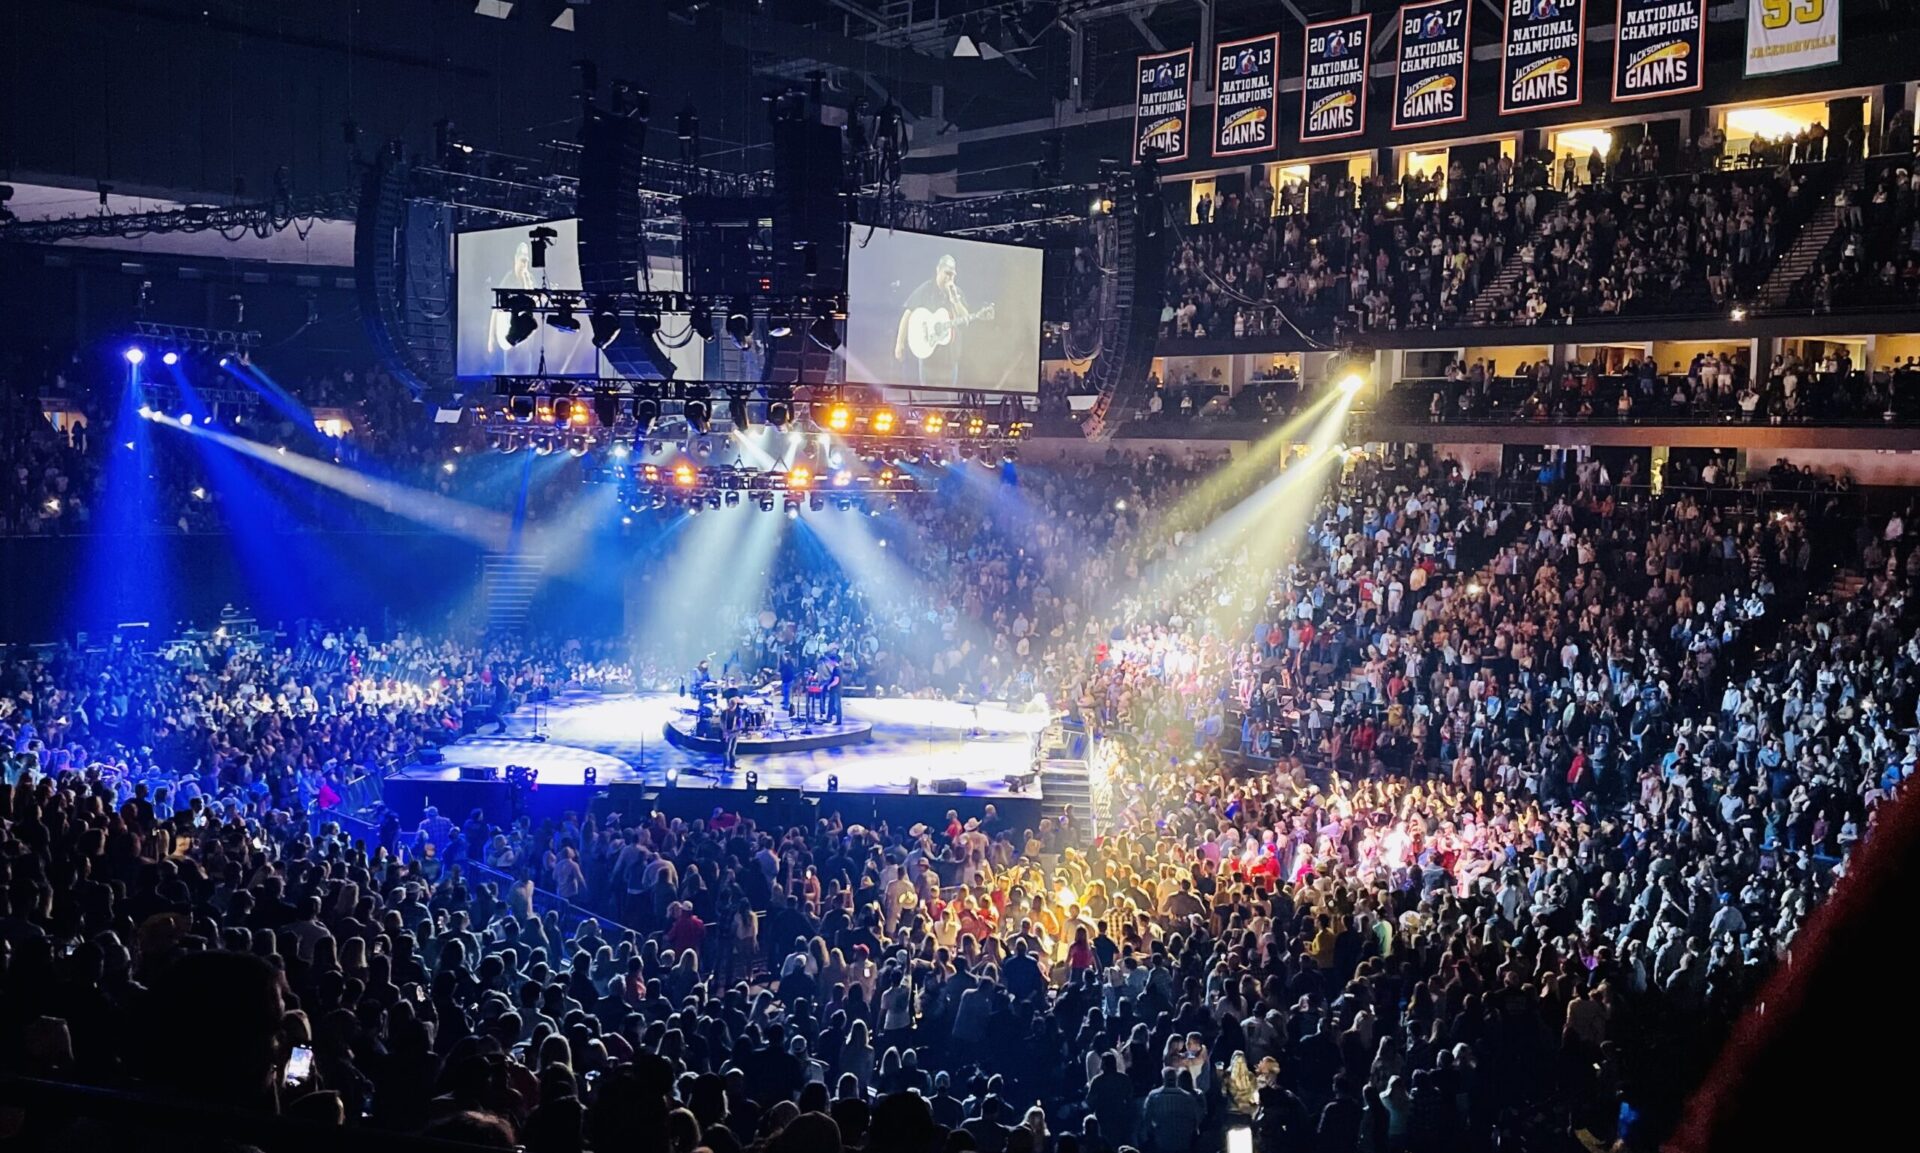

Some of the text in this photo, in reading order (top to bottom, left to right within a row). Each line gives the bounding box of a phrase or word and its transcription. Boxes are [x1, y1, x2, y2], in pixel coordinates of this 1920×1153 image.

[1512, 0, 1531, 16] 20
[1626, 1, 1694, 25] NATIONAL
[1405, 9, 1462, 35] 20 17
[1513, 19, 1574, 42] NATIONAL
[1621, 15, 1698, 41] CHAMPIONS
[1310, 30, 1362, 54] 20 16
[1405, 38, 1460, 59] NATIONAL
[1507, 33, 1578, 57] CHAMPIONS
[1222, 49, 1271, 71] 20 13
[1401, 51, 1463, 73] CHAMPIONS
[1626, 39, 1682, 70] JACKSONVI
[1142, 63, 1186, 83] 20 12
[1310, 58, 1360, 77] NATIONAL
[1512, 55, 1562, 84] JACKSONVI
[1625, 57, 1687, 89] GIANTS
[1222, 75, 1269, 93] NATIONAL
[1307, 70, 1363, 90] CHAMPIONS
[1404, 73, 1449, 101] JACKSONVI
[1512, 70, 1568, 102] GIANTS
[1139, 99, 1186, 117] CHAMPIONS
[1142, 88, 1184, 105] NATIONAL
[1219, 87, 1273, 106] CHAMPIONS
[1310, 90, 1350, 115] JACKSONVI
[1403, 89, 1454, 118] GIANTS
[1222, 106, 1261, 130] JACKSONV
[1309, 105, 1354, 132] GIANTS
[1221, 120, 1265, 146] GIANTS
